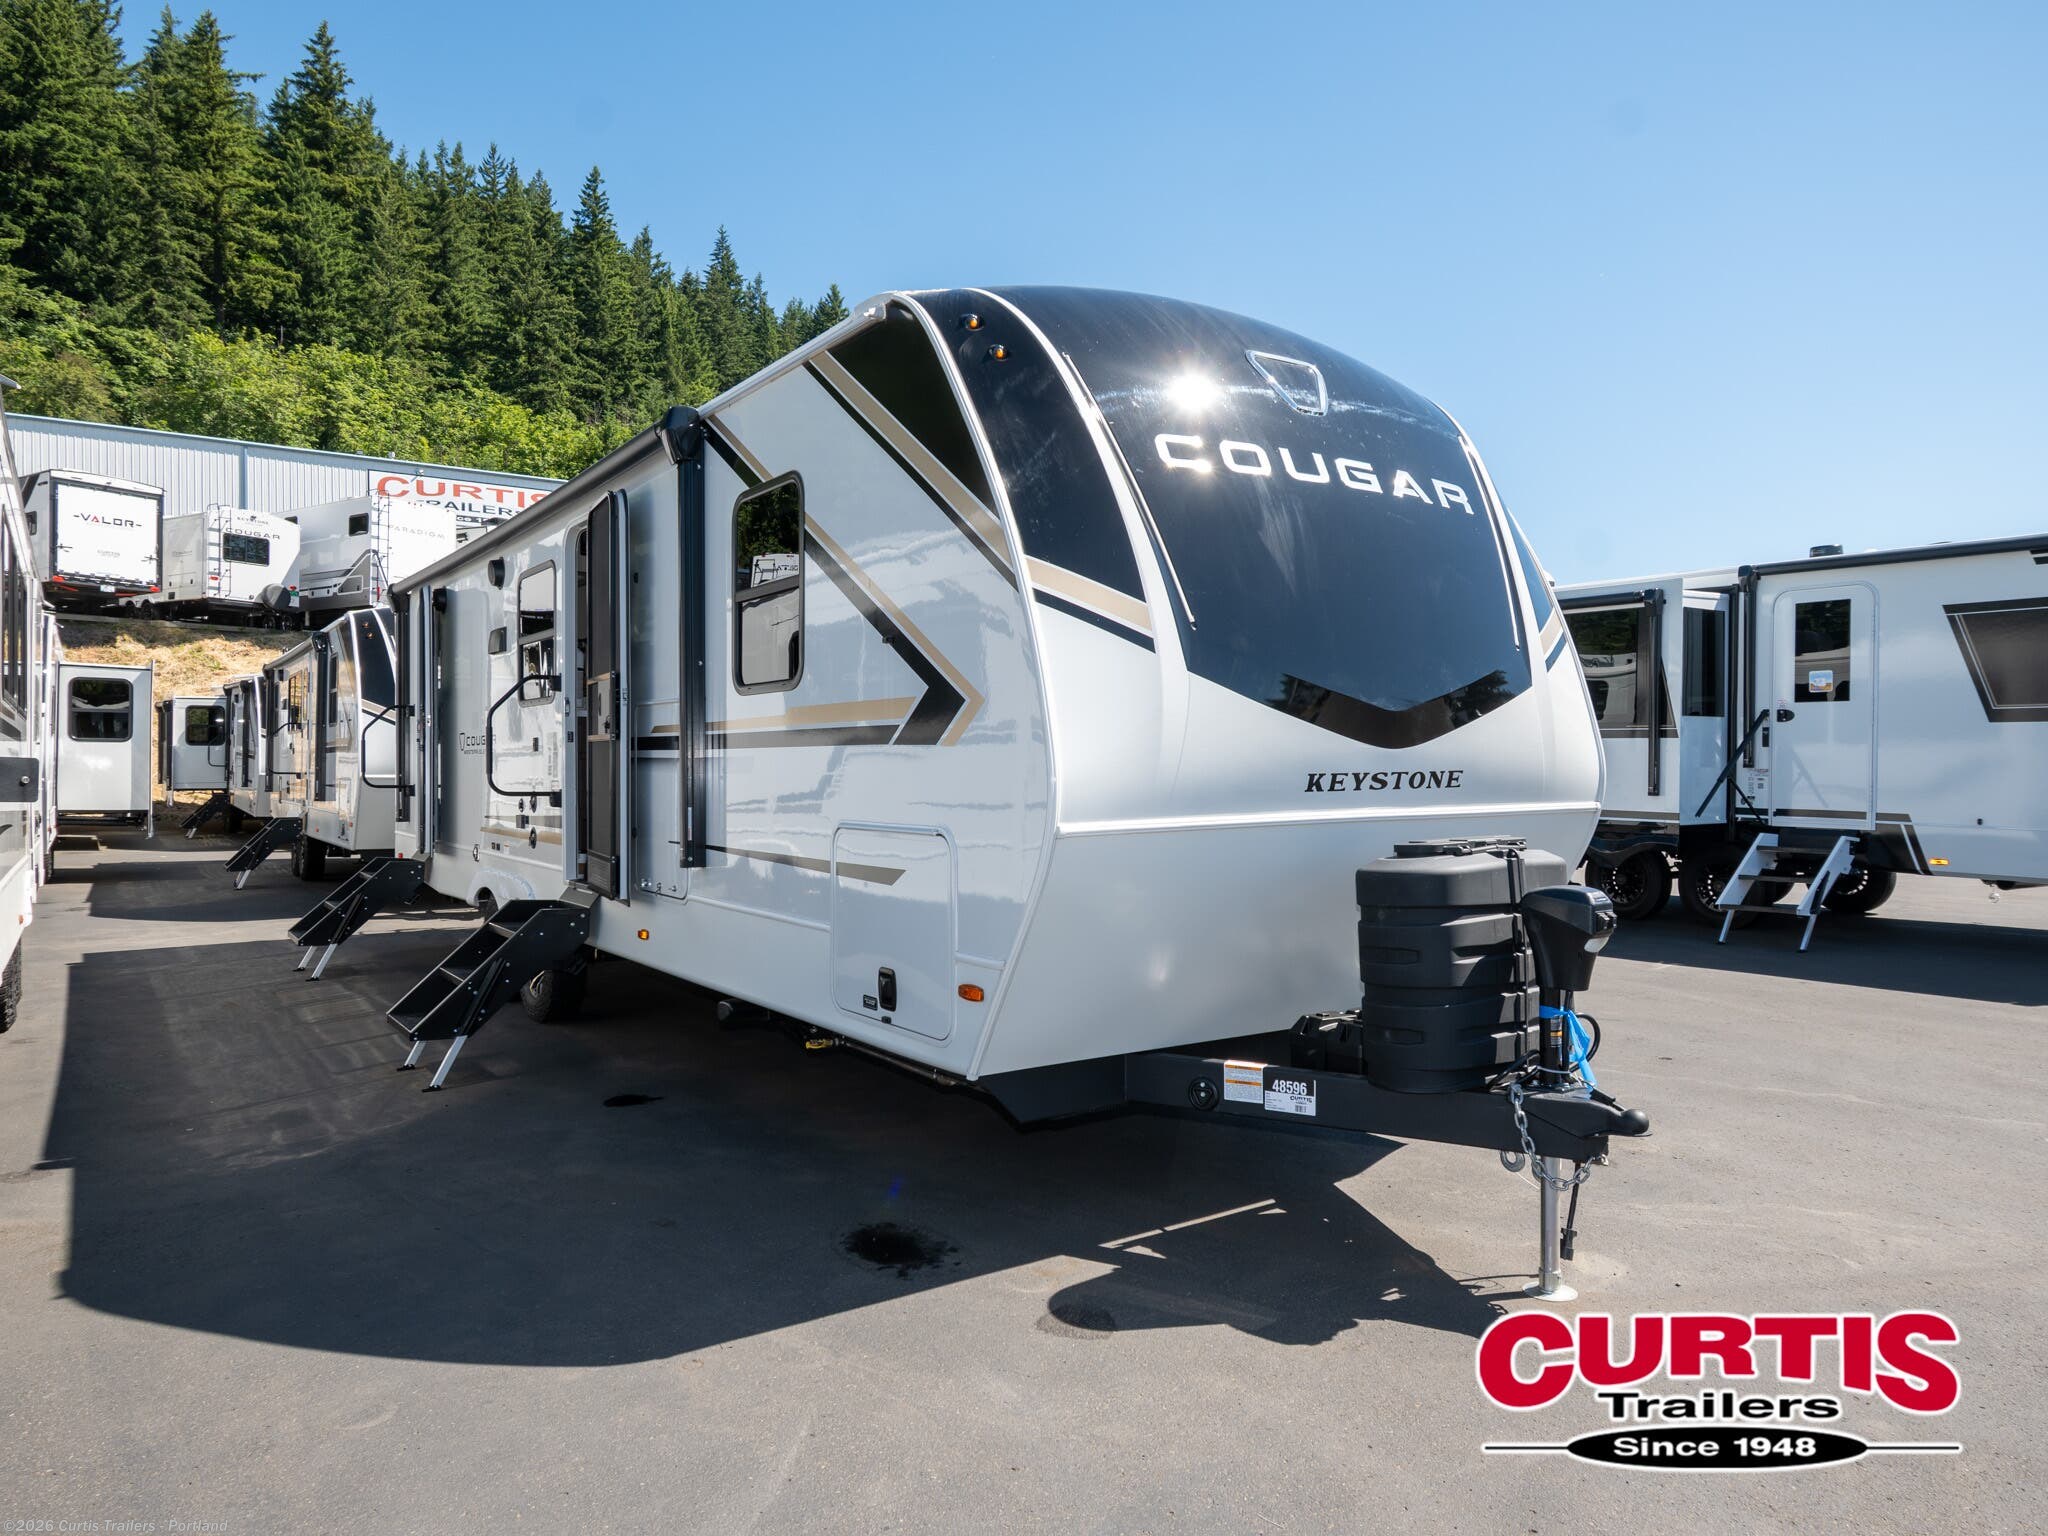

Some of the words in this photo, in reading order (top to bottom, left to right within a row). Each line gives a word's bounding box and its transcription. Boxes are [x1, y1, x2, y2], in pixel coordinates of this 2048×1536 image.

[1154, 433, 1475, 515] COUGAR
[416, 499, 521, 517] AILER
[226, 527, 281, 540] COUGAR
[389, 524, 445, 540] PARADIGM
[1305, 769, 1464, 793] KEYSTONE
[1272, 1080, 1307, 1095] 48596
